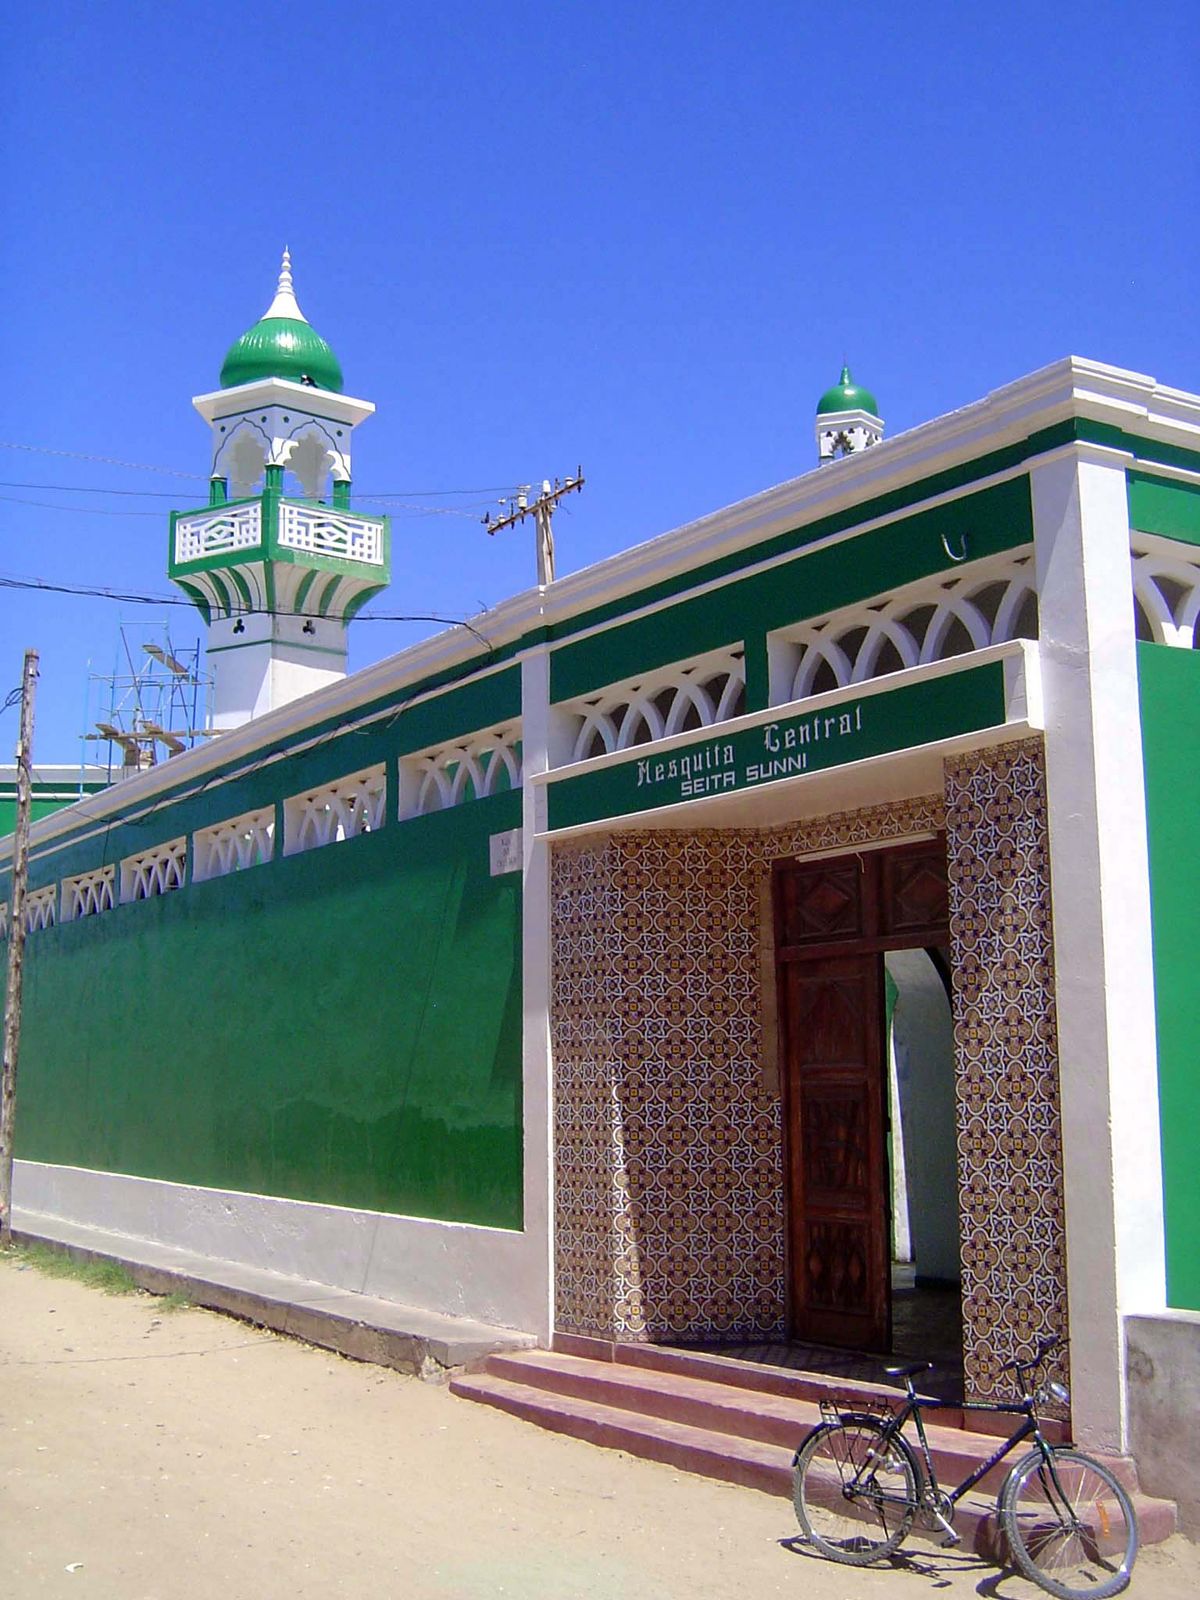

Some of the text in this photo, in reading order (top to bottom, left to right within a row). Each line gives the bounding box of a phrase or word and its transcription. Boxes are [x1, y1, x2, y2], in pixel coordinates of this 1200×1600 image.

[637, 705, 862, 787] Mesquita Central
[680, 752, 807, 796] SEITA SUNNI
